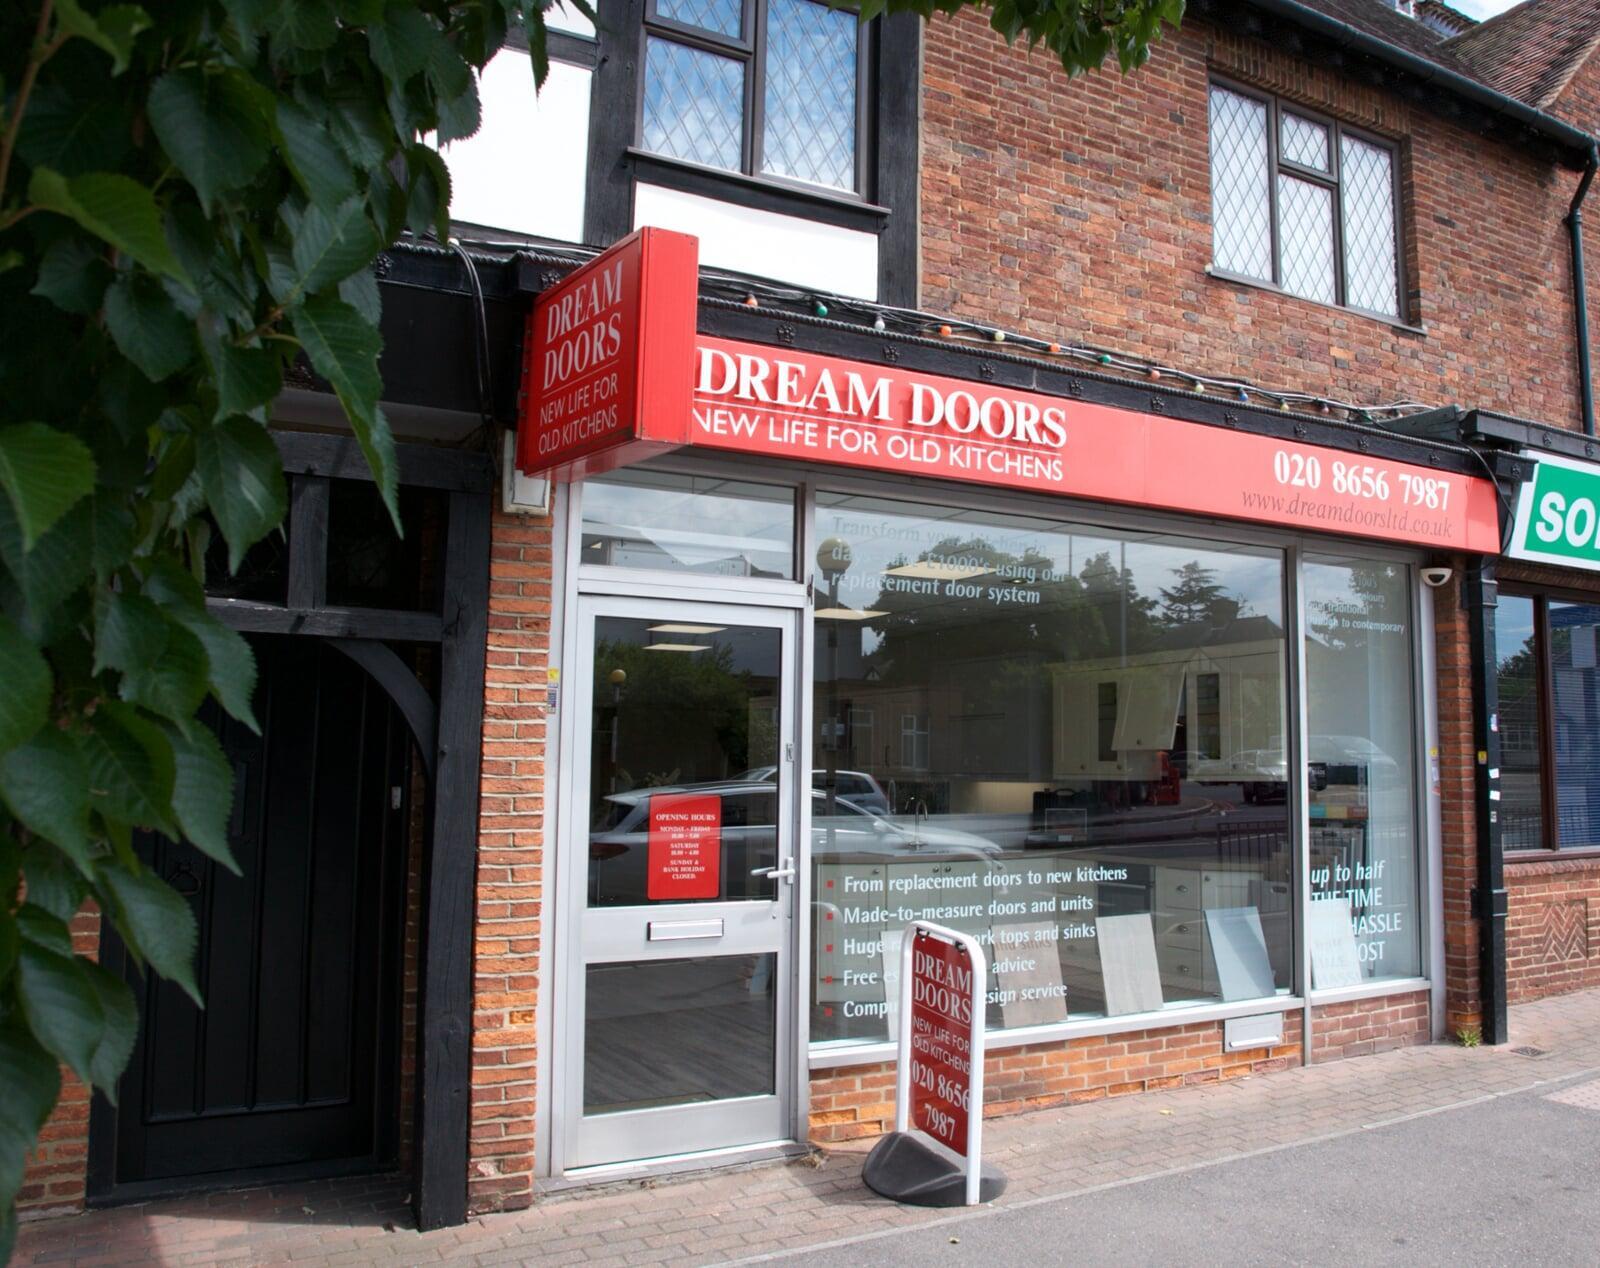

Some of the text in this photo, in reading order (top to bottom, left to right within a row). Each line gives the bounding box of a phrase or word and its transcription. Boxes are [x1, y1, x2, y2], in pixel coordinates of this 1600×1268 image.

[546, 260, 623, 344] DREAM
[543, 312, 621, 389] DOORS
[540, 372, 618, 427] NEW LIFE FOR
[695, 346, 1067, 449] DREAM DOORS
[538, 404, 618, 455] OLD KITCHENS
[692, 407, 1064, 482] NEW LIFE FOR OLD KITCHENS
[1273, 450, 1451, 511] 020 8656 7987
[832, 516, 919, 541] Transform
[1242, 491, 1452, 539] www.dreamdoorsltd.co.uk
[1535, 491, 1600, 548] SO
[832, 570, 1042, 606] replacement door system
[996, 562, 1037, 585] using
[1041, 567, 1066, 583] our
[1341, 617, 1350, 629] to
[1351, 619, 1405, 636] contemporary
[656, 813, 716, 822] OPENING HOURS
[844, 866, 1128, 895] From replacement doors to new kitchens
[1311, 860, 1386, 888] up to half
[844, 896, 1093, 924] Made-to-measure doors and units
[1345, 887, 1383, 908] TIME
[844, 938, 886, 958] Huge
[974, 929, 995, 946] ork
[1000, 929, 1030, 946] tops
[1034, 925, 1060, 942] and
[1063, 924, 1096, 940] sinks
[1359, 941, 1386, 962] OST
[843, 969, 878, 987] Free
[992, 956, 1036, 974] advice
[915, 951, 972, 995] DREAM
[1021, 982, 1068, 1000] service
[914, 976, 971, 1024] DOORS
[913, 1015, 970, 1055] NEW LIFE FOR
[913, 1034, 970, 1075] OLD KITCHENS
[912, 1060, 970, 1113] 020 8656
[924, 1103, 955, 1142] 7987
